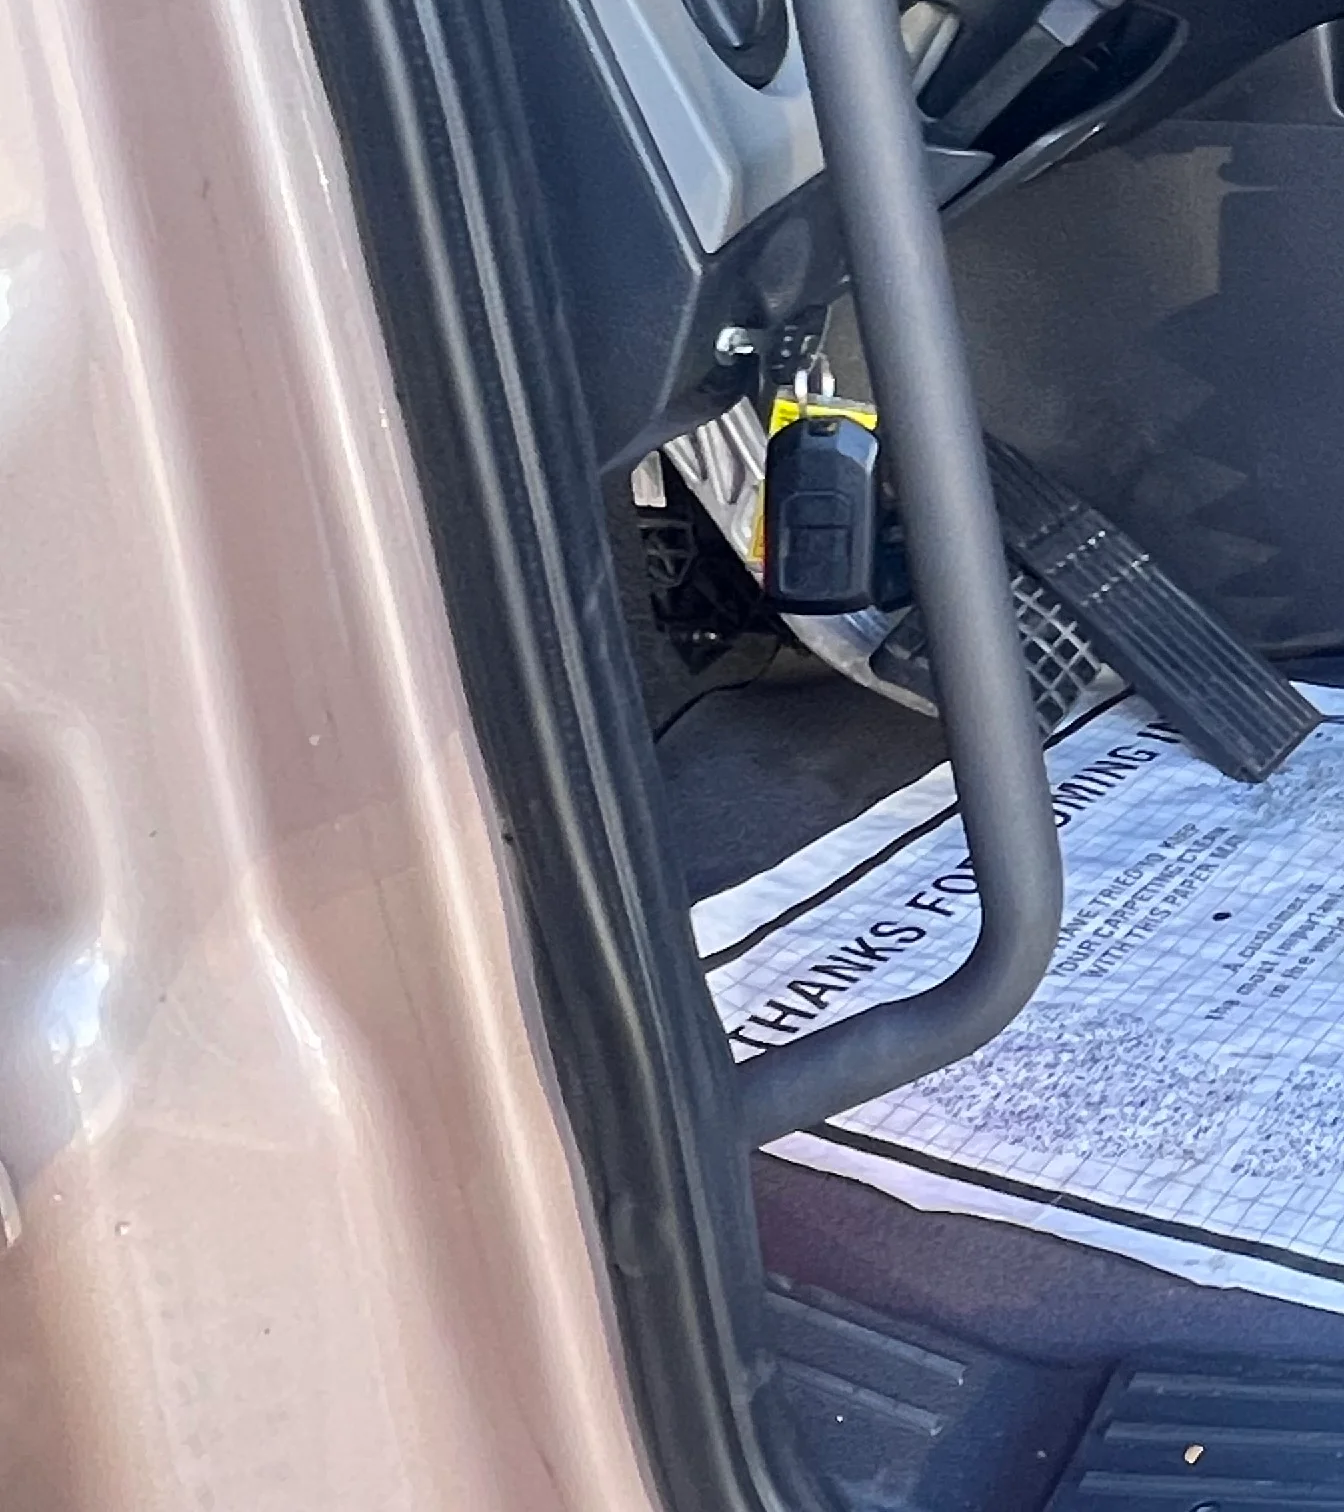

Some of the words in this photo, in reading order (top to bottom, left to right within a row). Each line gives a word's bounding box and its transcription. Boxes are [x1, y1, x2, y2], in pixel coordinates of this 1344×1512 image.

[729, 920, 926, 1052] THANKS
[906, 857, 979, 918] FO
[1053, 746, 1161, 828] MING
[1080, 941, 1136, 978] WITH
[1124, 906, 1172, 939] THIS
[1162, 863, 1220, 907] PAPER
